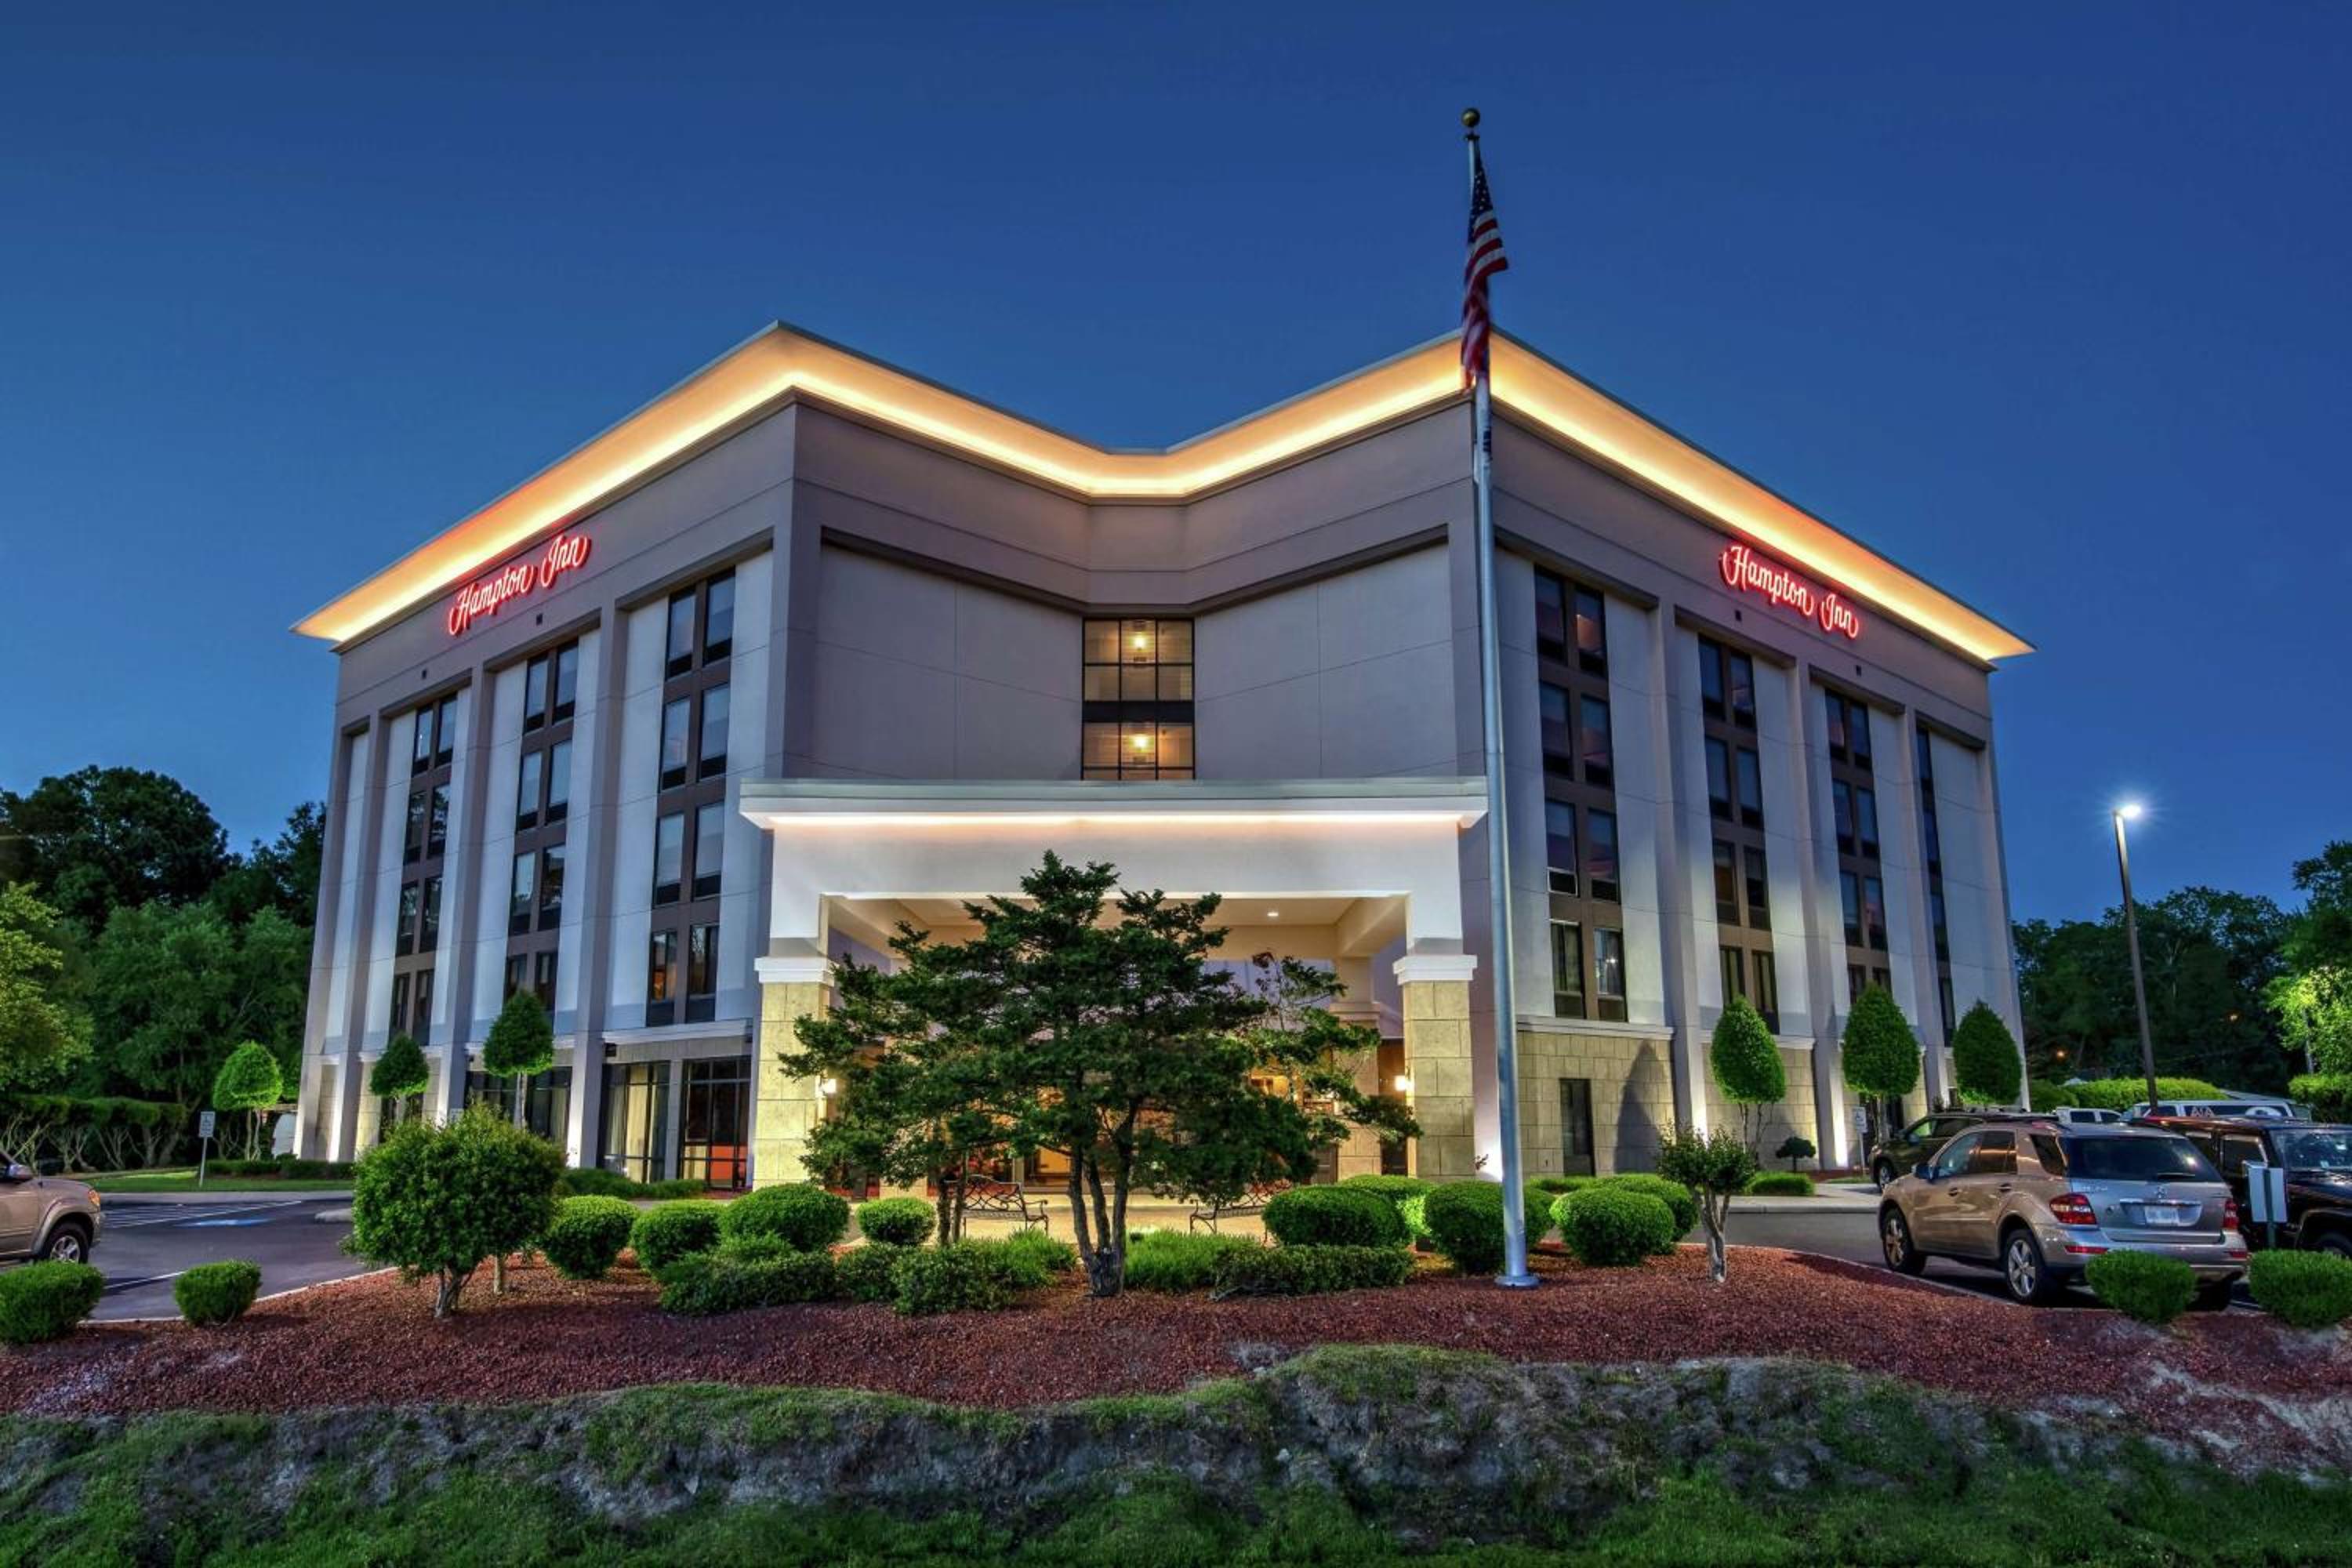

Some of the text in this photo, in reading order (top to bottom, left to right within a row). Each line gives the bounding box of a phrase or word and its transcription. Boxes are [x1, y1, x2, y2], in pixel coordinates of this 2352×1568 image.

[448, 533, 590, 636] Hampton Inn
[1719, 545, 1859, 639] Hampton Inn
